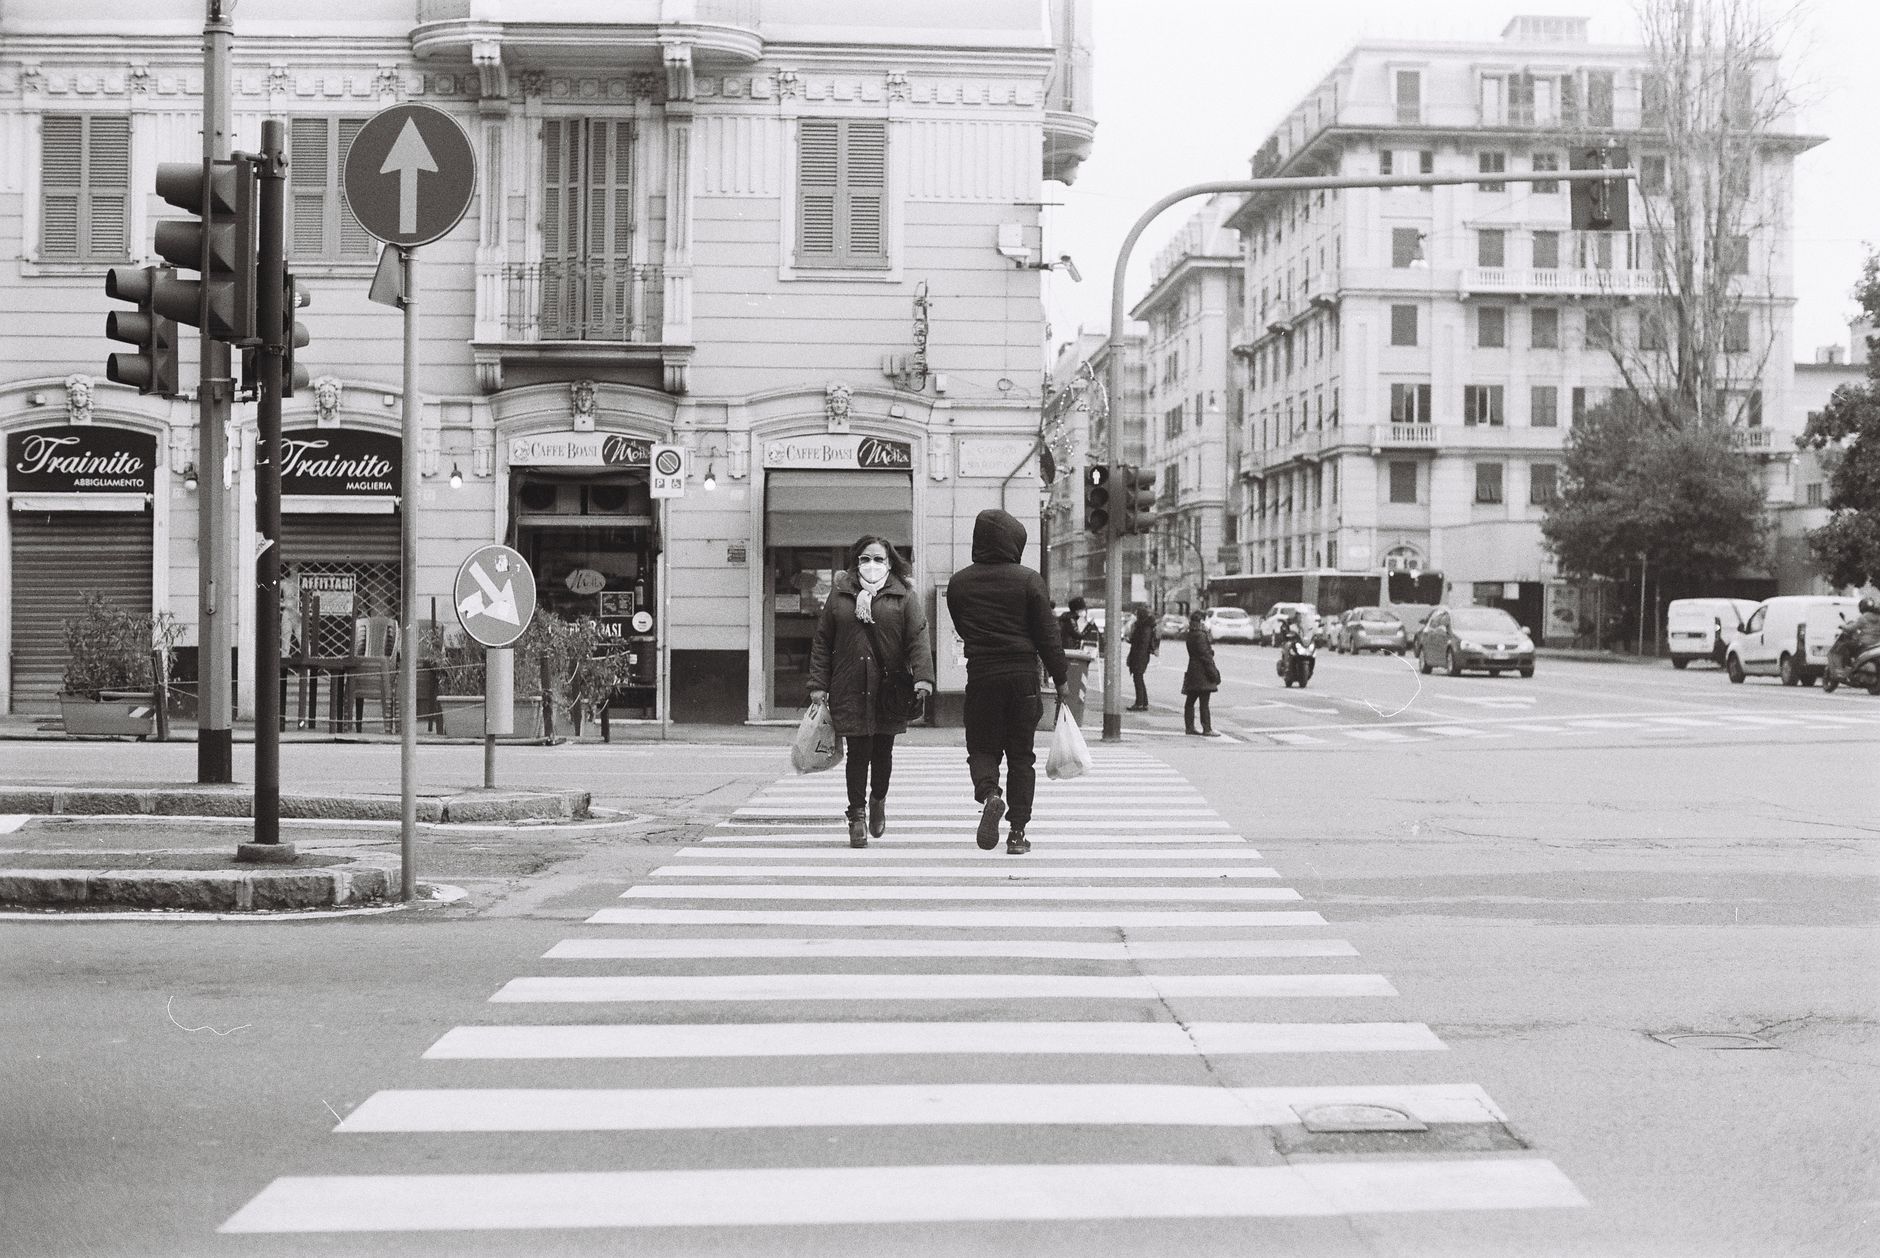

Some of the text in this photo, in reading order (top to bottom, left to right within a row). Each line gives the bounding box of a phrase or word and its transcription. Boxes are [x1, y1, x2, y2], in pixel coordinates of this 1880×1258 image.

[16, 434, 144, 474] Trainito
[281, 438, 393, 478] Trainito
[822, 444, 853, 462] BOASI
[73, 478, 145, 487] ABBIGLIAMENTO
[346, 481, 393, 491] MAGLIERIA
